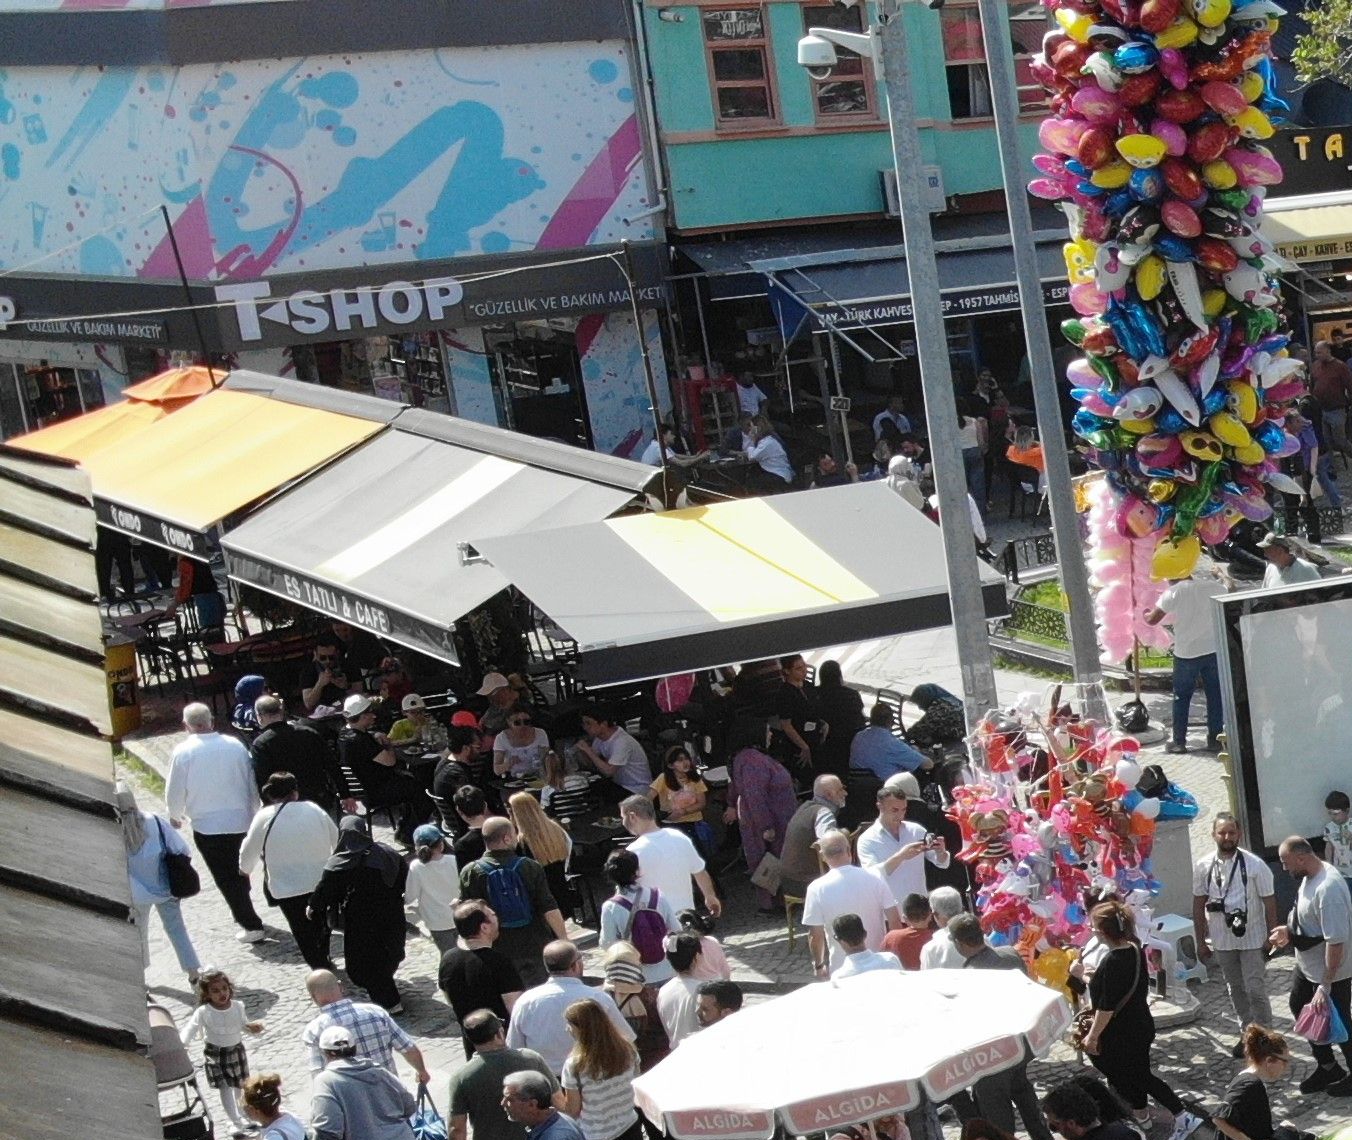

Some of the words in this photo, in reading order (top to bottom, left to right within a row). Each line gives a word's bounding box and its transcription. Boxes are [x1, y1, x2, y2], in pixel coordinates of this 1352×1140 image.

[540, 296, 557, 310] VE
[561, 292, 604, 309] BAKIM
[959, 296, 982, 309] 1957
[873, 304, 914, 320] KAHVES
[284, 574, 301, 599] ES
[303, 580, 338, 613] TATLI
[341, 596, 352, 618] &
[355, 600, 388, 633] CAFE
